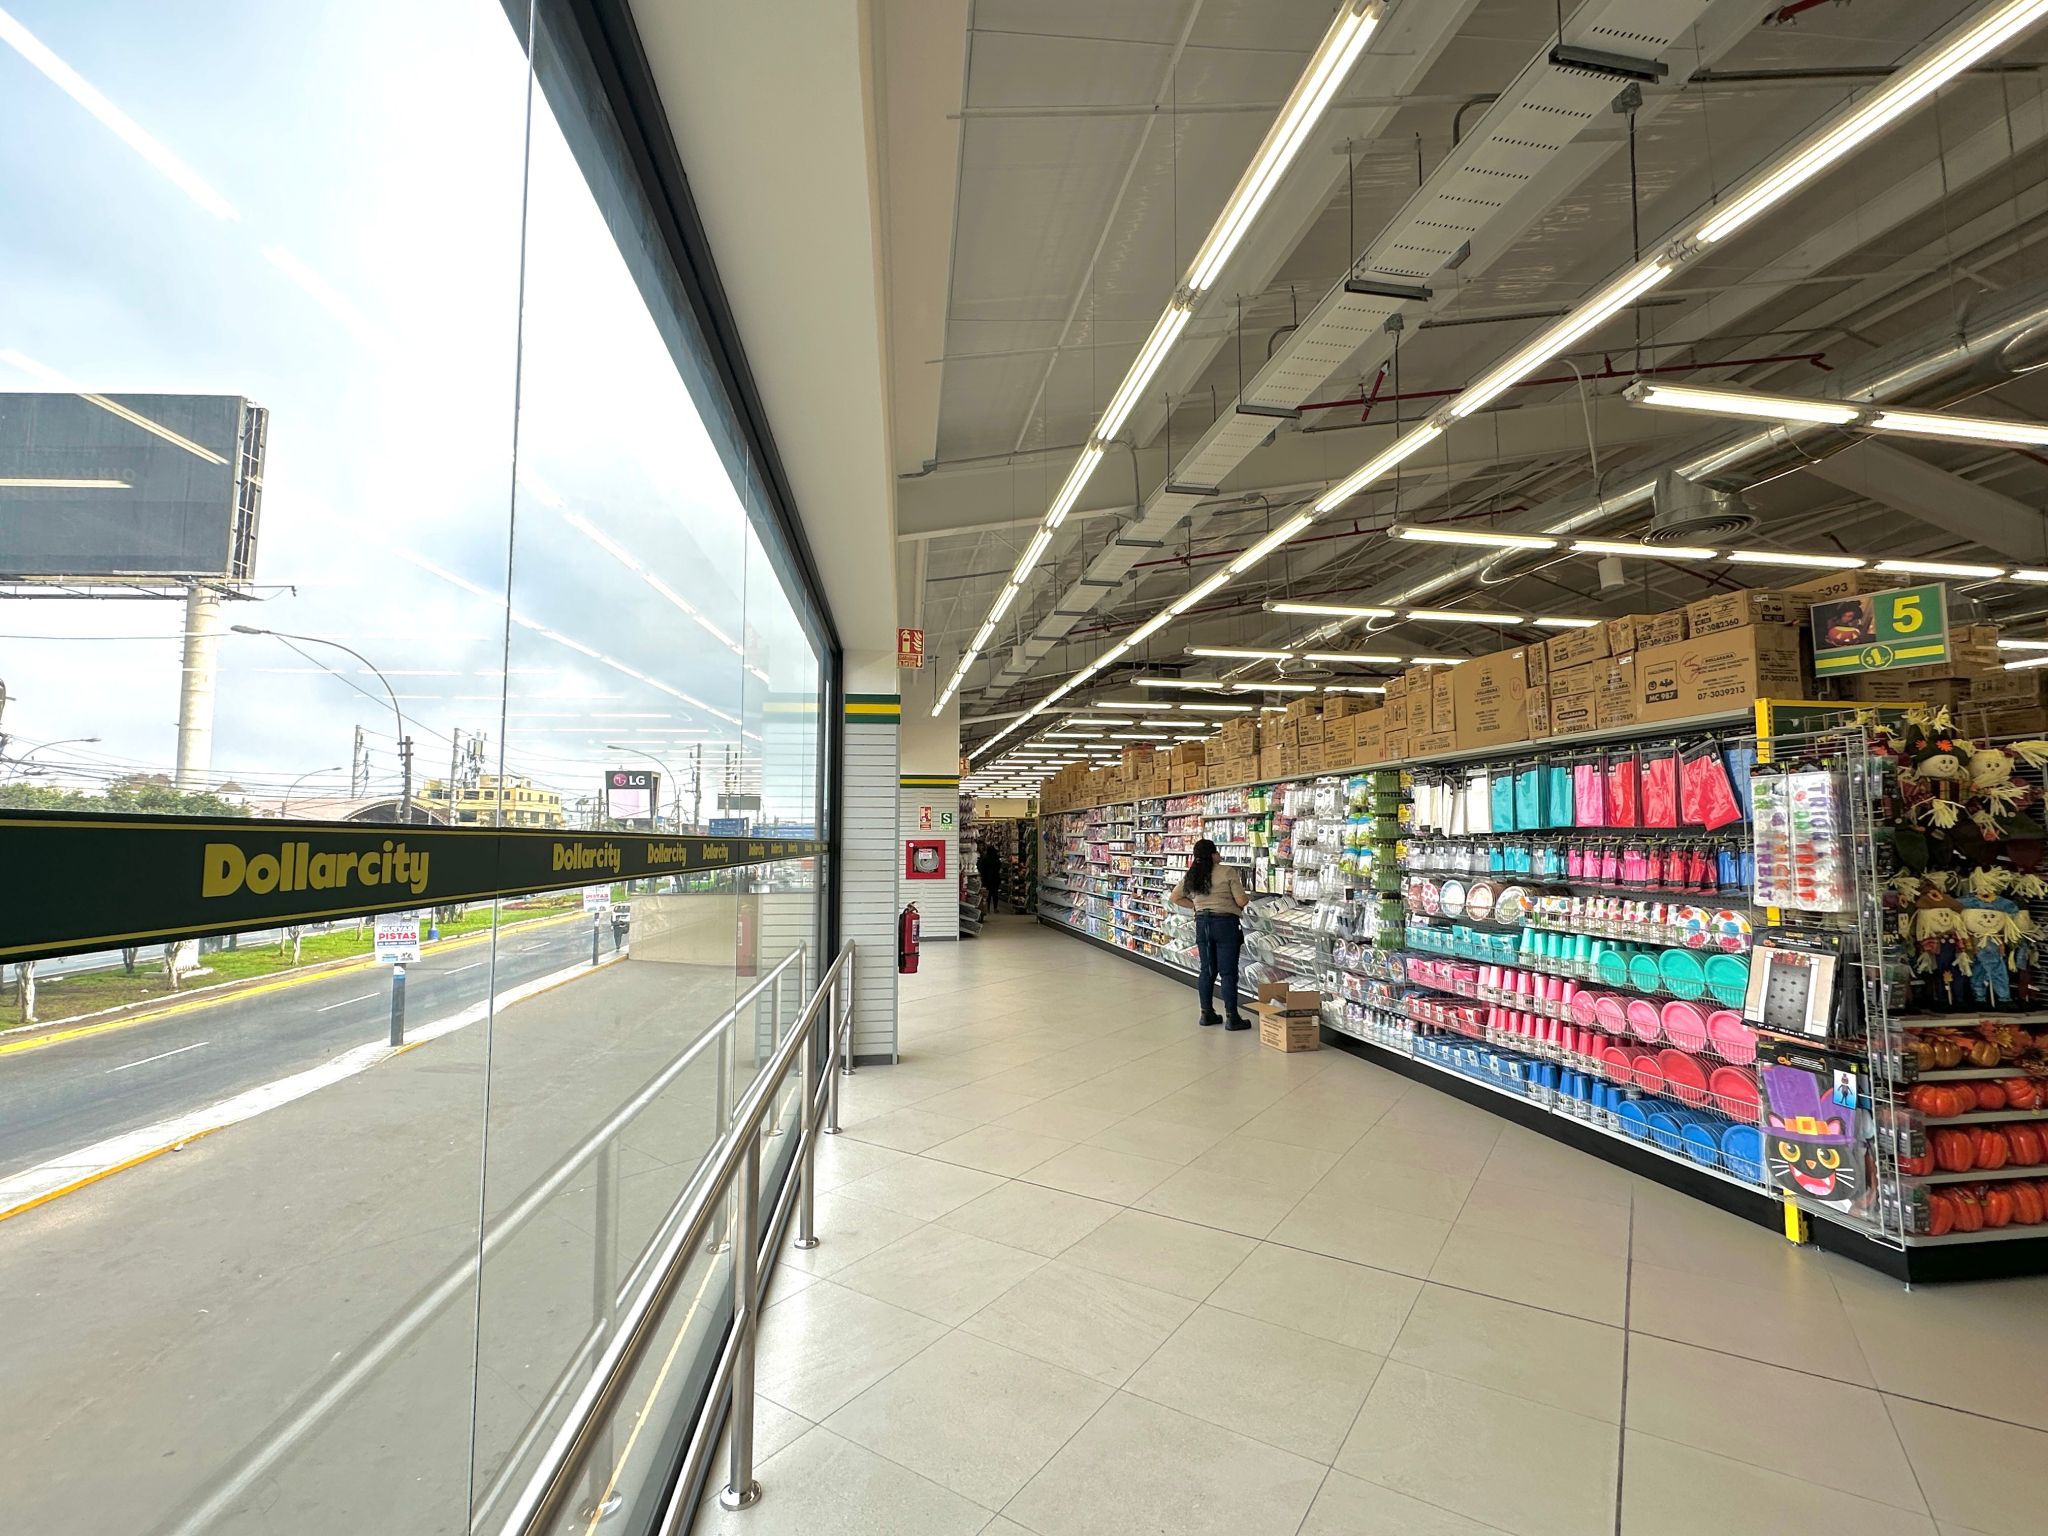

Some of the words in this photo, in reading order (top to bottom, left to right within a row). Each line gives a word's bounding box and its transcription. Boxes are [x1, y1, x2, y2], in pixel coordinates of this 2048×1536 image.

[1892, 595, 1923, 633] 5
[1697, 686, 1746, 700] 07-3039213
[628, 775, 646, 786] LG
[942, 813, 951, 824] S
[552, 841, 621, 873] Dollarcity
[647, 842, 687, 867] Dollarcity
[201, 840, 430, 898] Dollarcity
[378, 932, 417, 940] PISTAS
